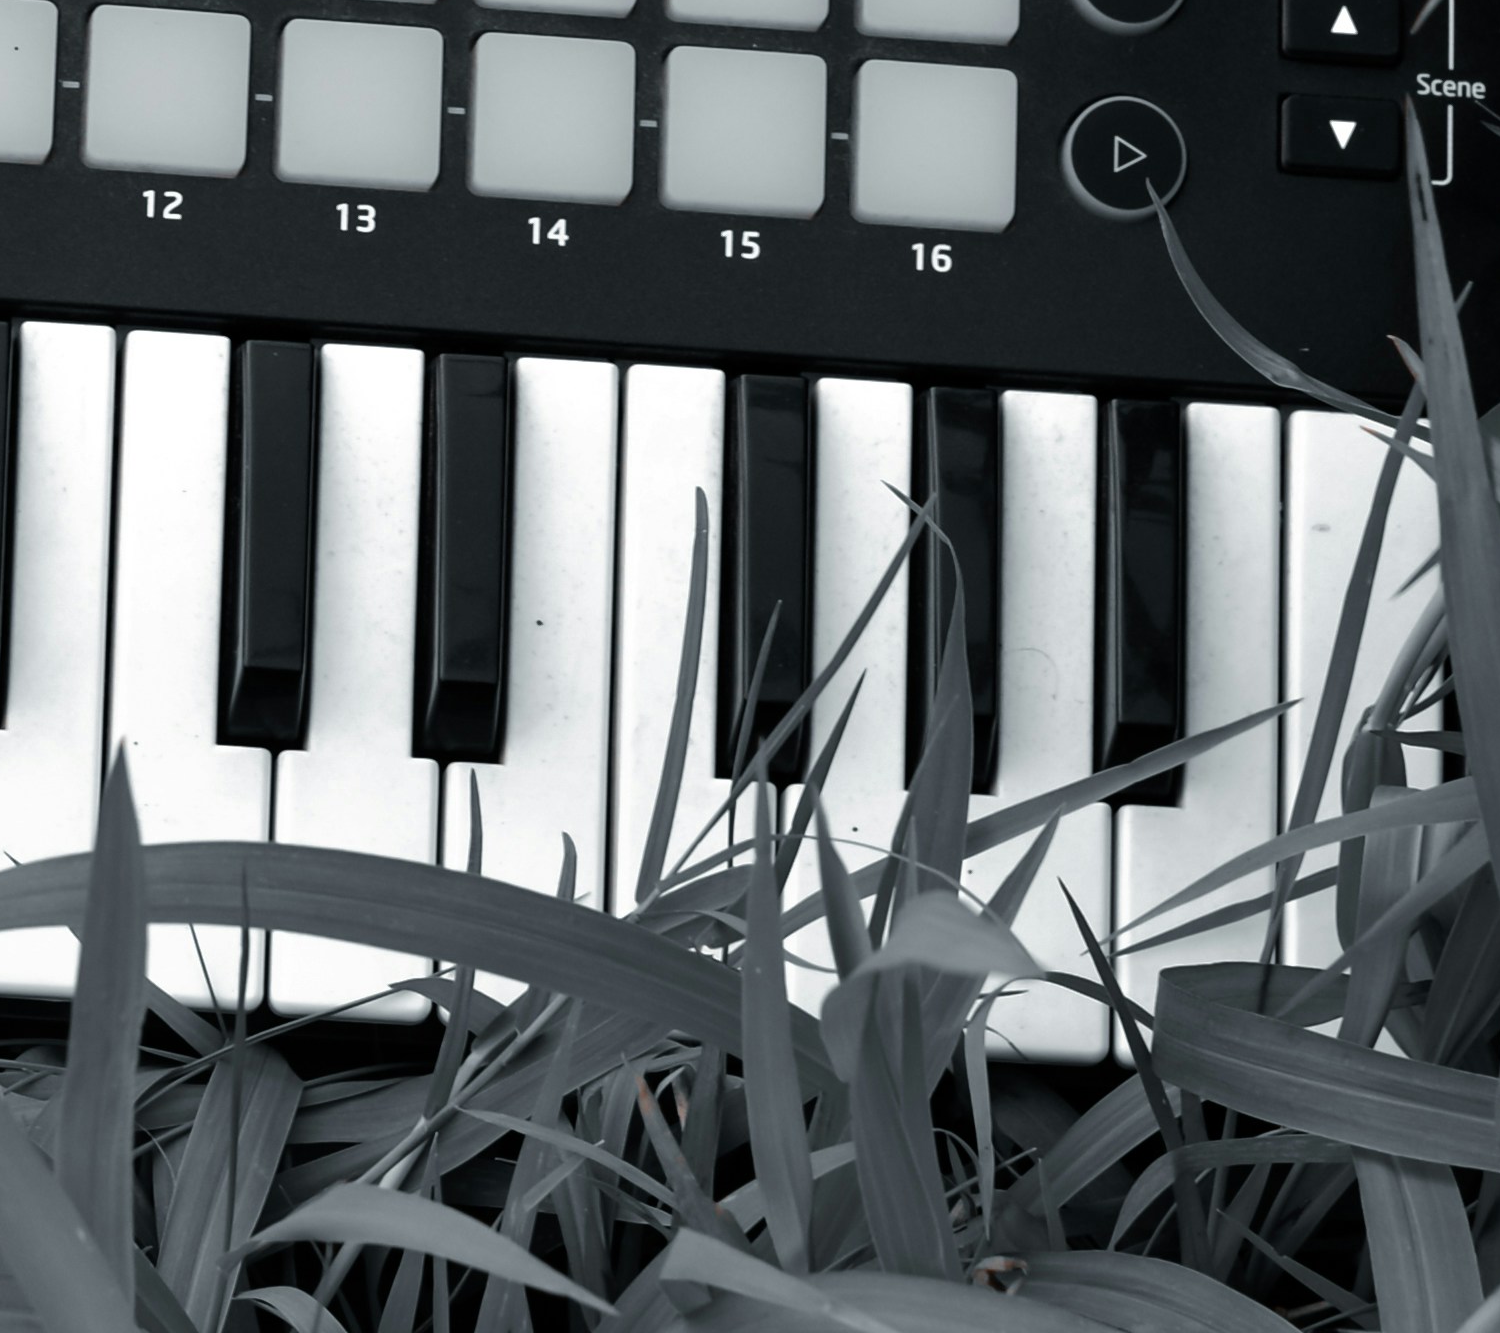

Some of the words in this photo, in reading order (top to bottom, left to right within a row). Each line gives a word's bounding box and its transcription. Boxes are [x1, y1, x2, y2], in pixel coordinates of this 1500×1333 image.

[1416, 73, 1486, 100] Scene
[142, 189, 184, 220] 12
[335, 202, 377, 233] 13
[527, 216, 570, 247] 14
[720, 229, 761, 260] 15
[911, 242, 953, 273] 16
